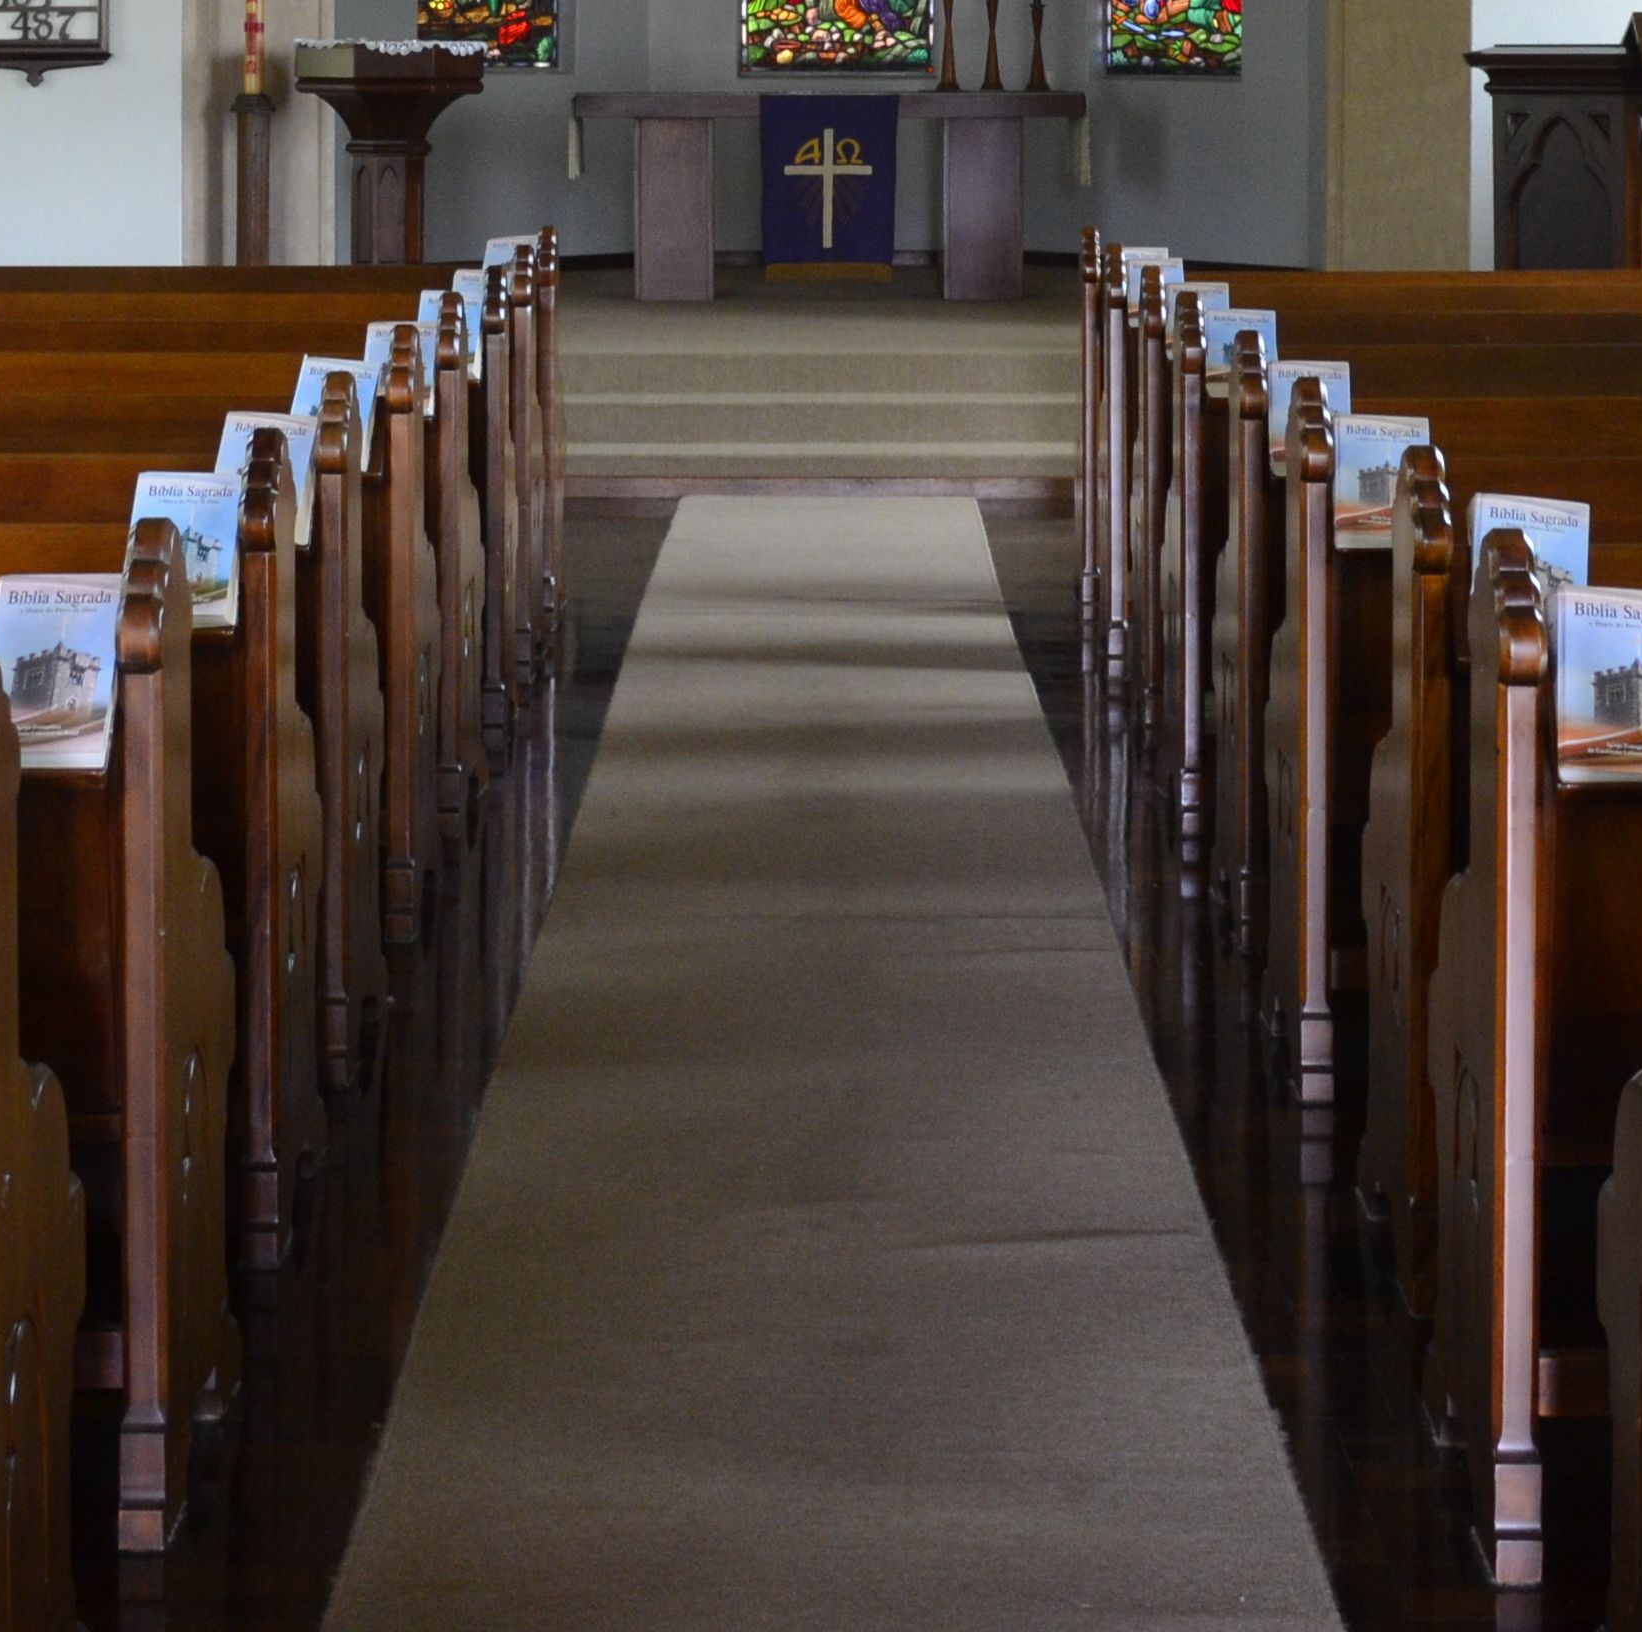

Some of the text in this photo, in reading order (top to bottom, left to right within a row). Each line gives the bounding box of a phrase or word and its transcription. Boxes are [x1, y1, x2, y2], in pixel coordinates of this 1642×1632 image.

[10, 10, 77, 40] 487
[186, 485, 234, 501] Sagrada
[1530, 510, 1578, 529] Sagrada
[54, 590, 112, 612] Sagrada
